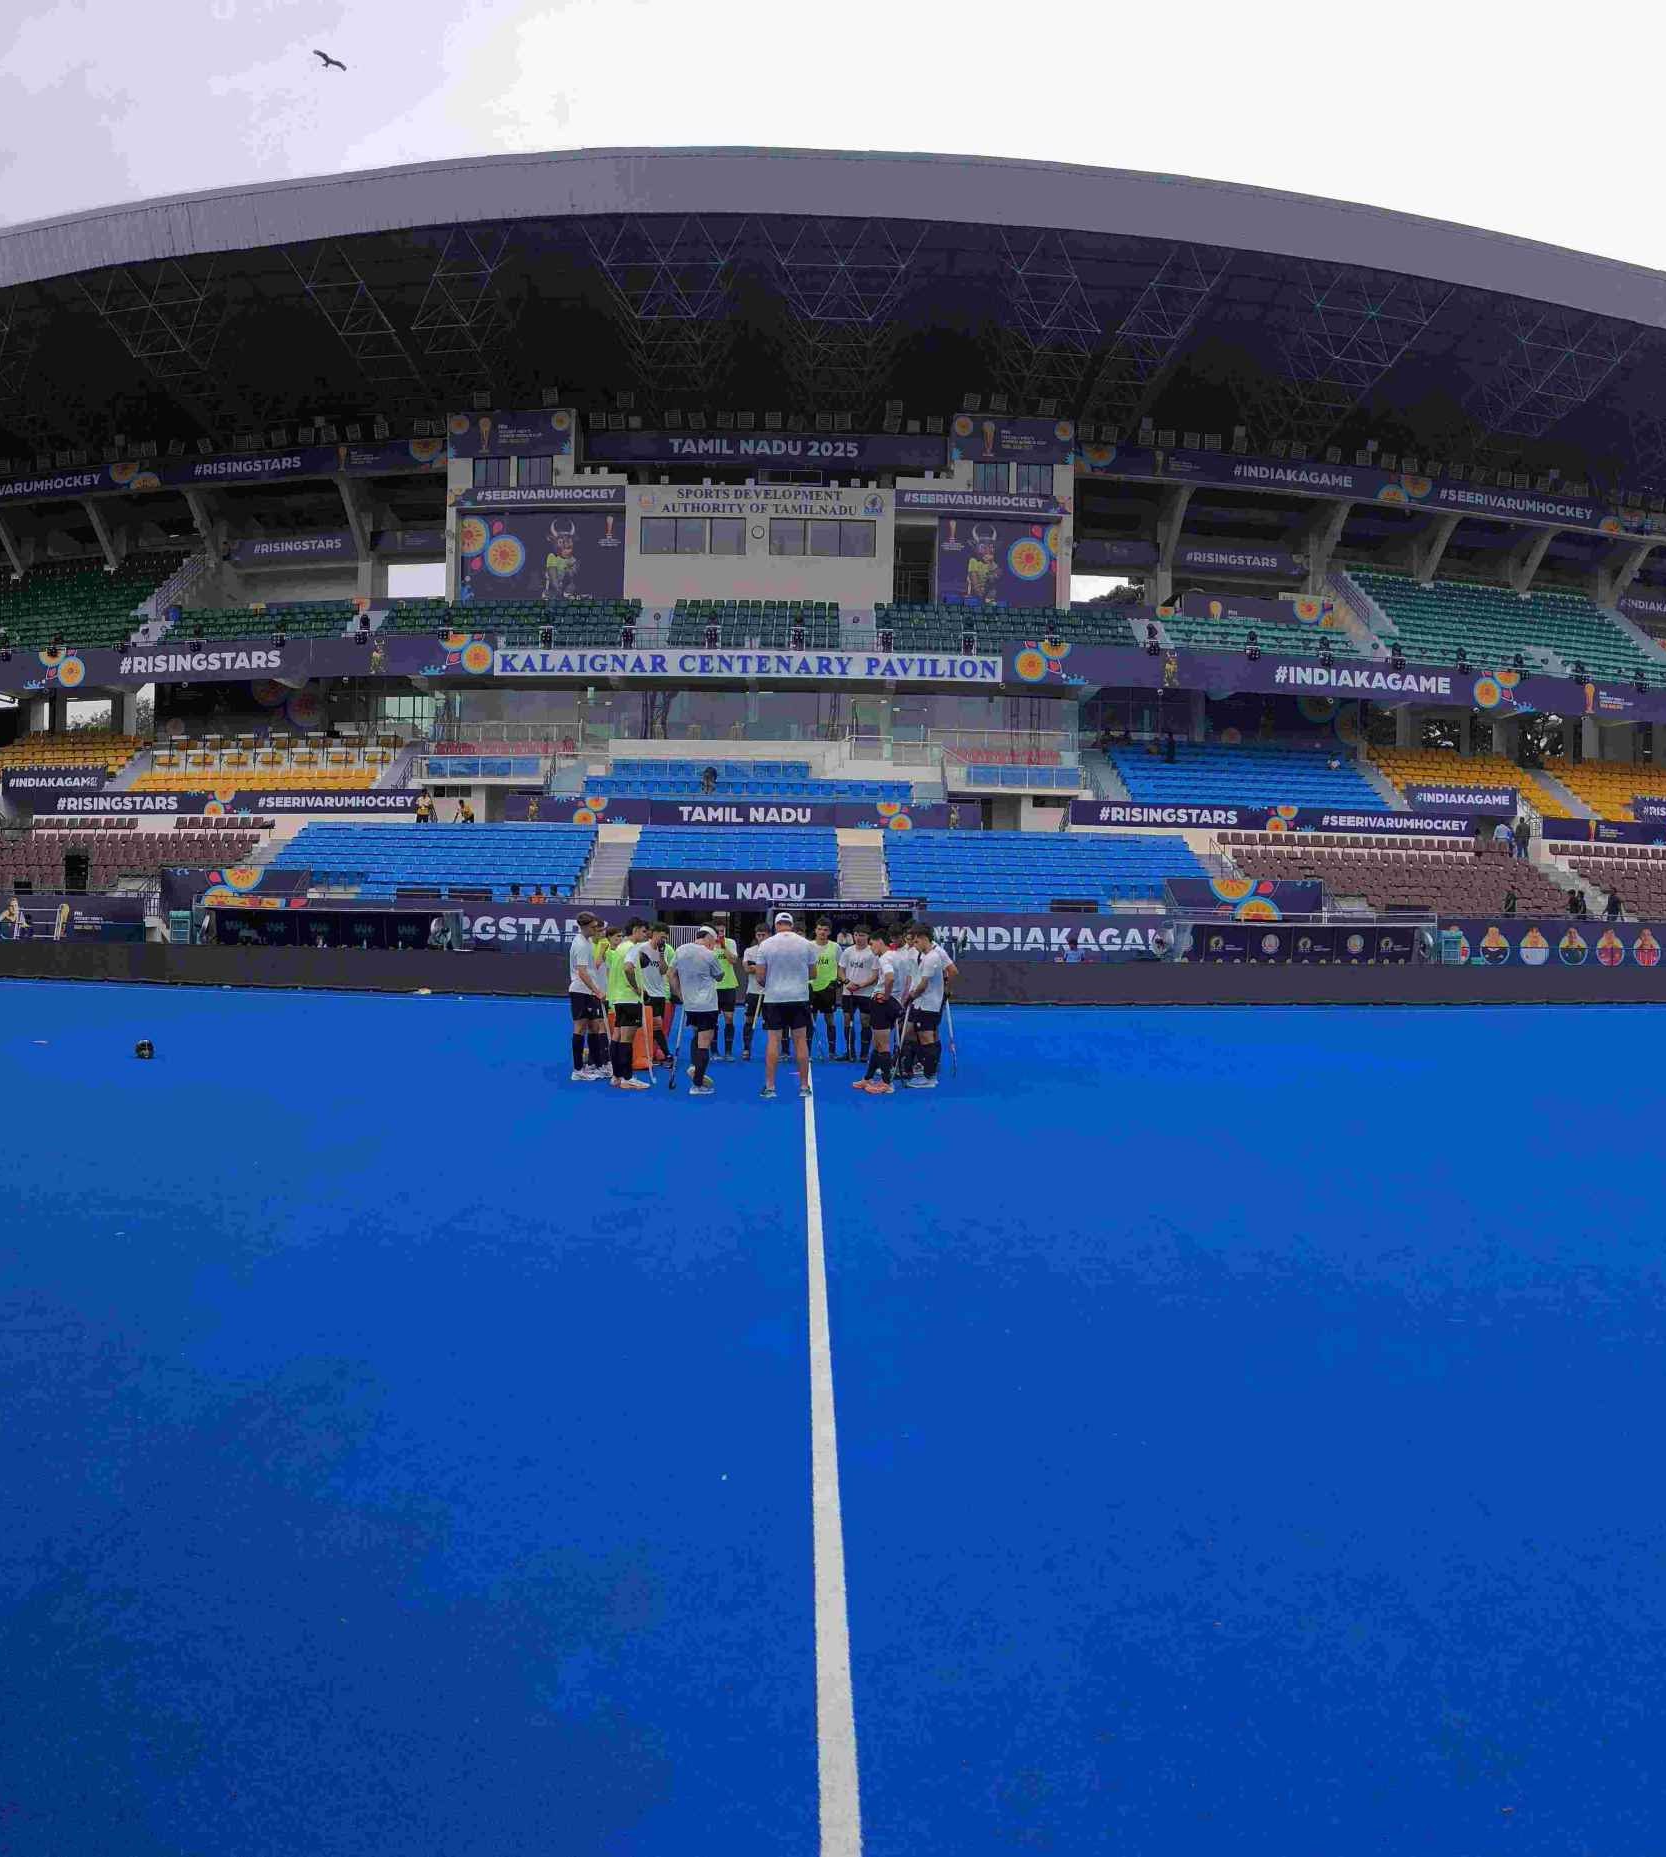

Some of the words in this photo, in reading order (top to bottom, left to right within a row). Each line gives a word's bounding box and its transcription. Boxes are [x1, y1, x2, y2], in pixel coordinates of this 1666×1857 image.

[669, 438, 734, 455] TAMIL
[740, 439, 802, 456] NADU
[807, 440, 859, 458] 2025
[194, 456, 302, 477] #RISINGSTARS
[1233, 462, 1353, 488] #INDIAKAGAME
[476, 487, 617, 501] #SEERIVARUMHOCKEY
[676, 488, 730, 499] SPORTS
[732, 488, 843, 501] DEVELOPMENT
[904, 492, 1046, 509] #SEERIVARUMHOCKEY
[661, 503, 745, 514] AUTHORITY
[750, 503, 768, 514] OF
[772, 503, 859, 516] TAMILNADU
[1439, 488, 1594, 520] #SEERIVARUMHOCKEY
[254, 538, 342, 554] #RISINGSTARS
[1186, 551, 1278, 568] #RISINGSTARS
[120, 649, 282, 675] #RISINGSTARS
[500, 653, 667, 674] KALAIGNAR
[678, 653, 854, 676] CENTENARY
[866, 656, 999, 680] PAVILION
[1274, 664, 1452, 695] #INDIAKAGAME
[56, 795, 178, 812] #RISINGSTARS
[257, 794, 414, 809] #SEERIVARUMHOCKEY
[1416, 791, 1510, 806] #INDIAKAGAME
[678, 806, 744, 823] TAMIL
[749, 807, 812, 823] NADU
[1099, 805, 1238, 825] #RISINGSTARS
[1321, 813, 1468, 832] #SEERIVARUMHOCKEY
[656, 880, 730, 900] TAMIL
[735, 881, 806, 901] NADU
